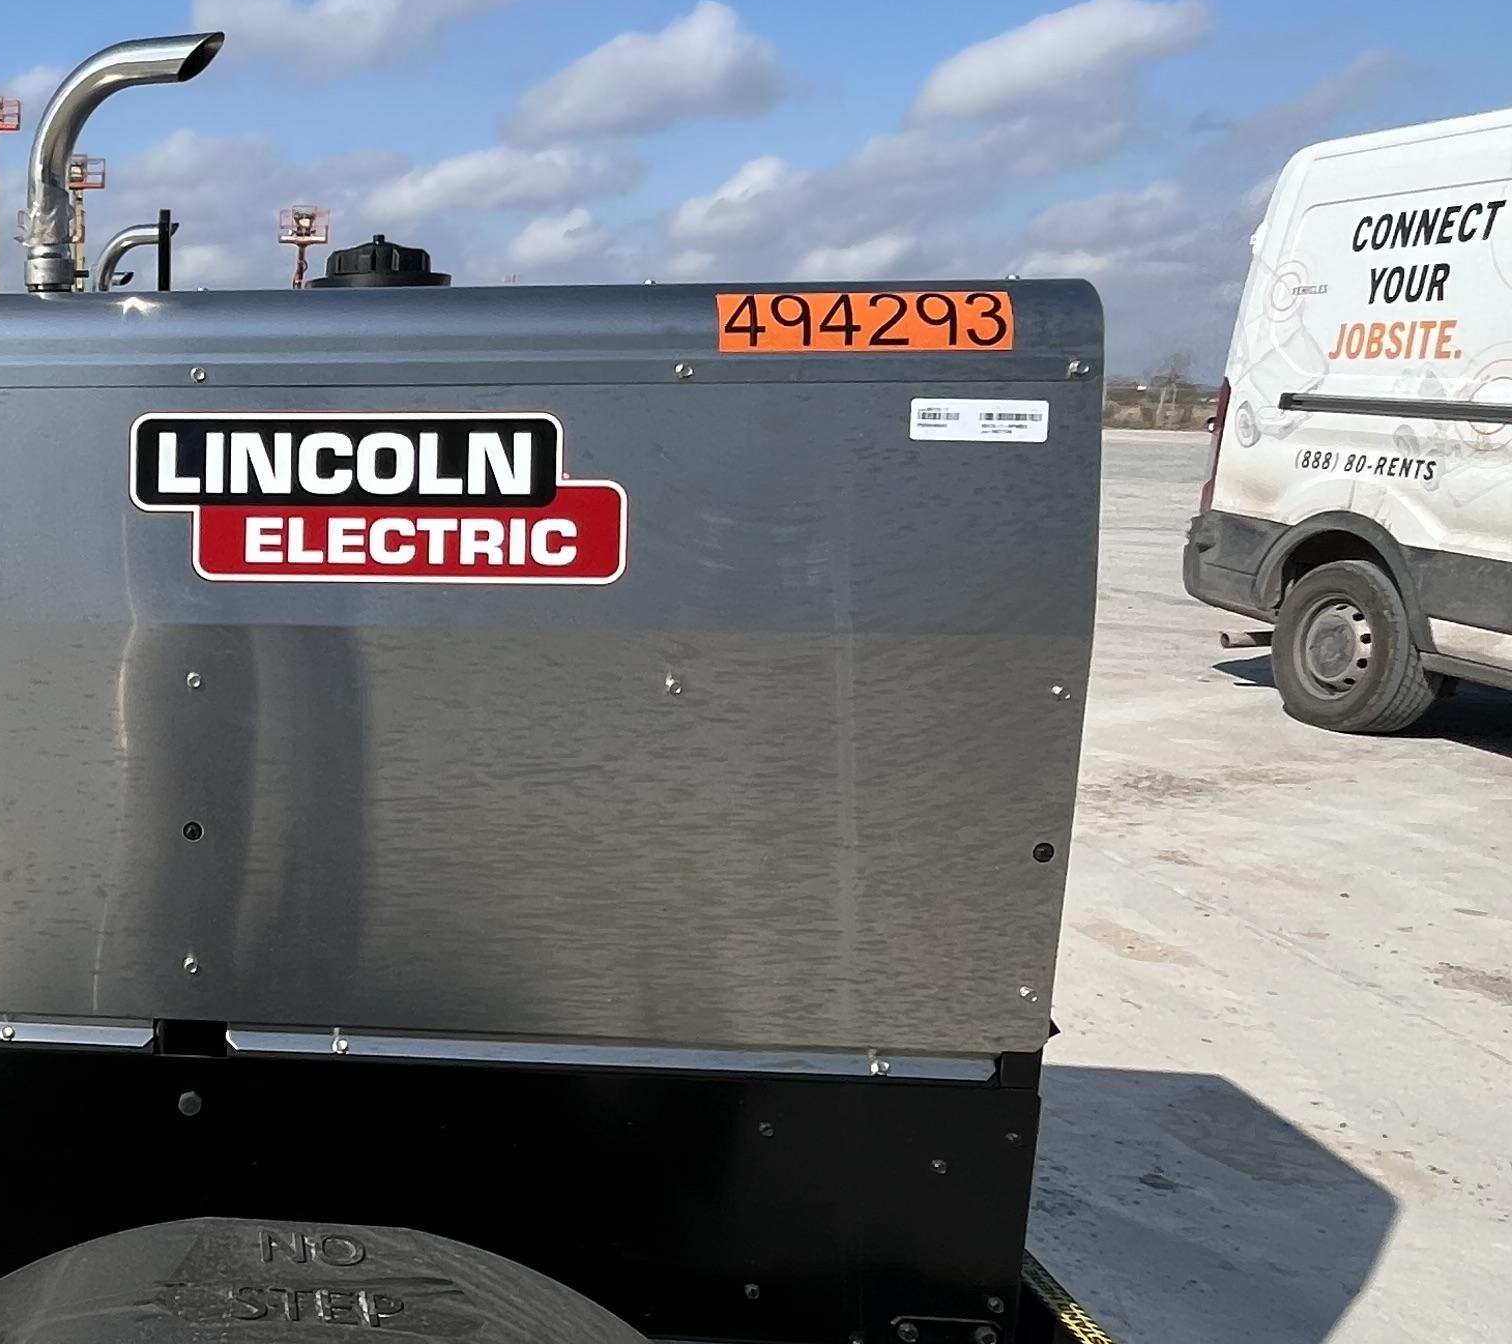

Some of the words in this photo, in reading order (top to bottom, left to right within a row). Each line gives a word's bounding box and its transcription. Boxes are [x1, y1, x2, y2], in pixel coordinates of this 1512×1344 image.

[1352, 199, 1507, 253] CONNECT
[1368, 263, 1450, 305] YOUR
[724, 292, 1007, 347] 494293
[1328, 320, 1463, 360] JOBSITE.
[158, 431, 533, 496] LINCOLN
[1295, 449, 1339, 472] (888)
[1344, 454, 1437, 481] 80-RENTS
[244, 516, 578, 567] ELECTRIC
[258, 1231, 367, 1268] NO
[228, 1286, 405, 1328] STEP
